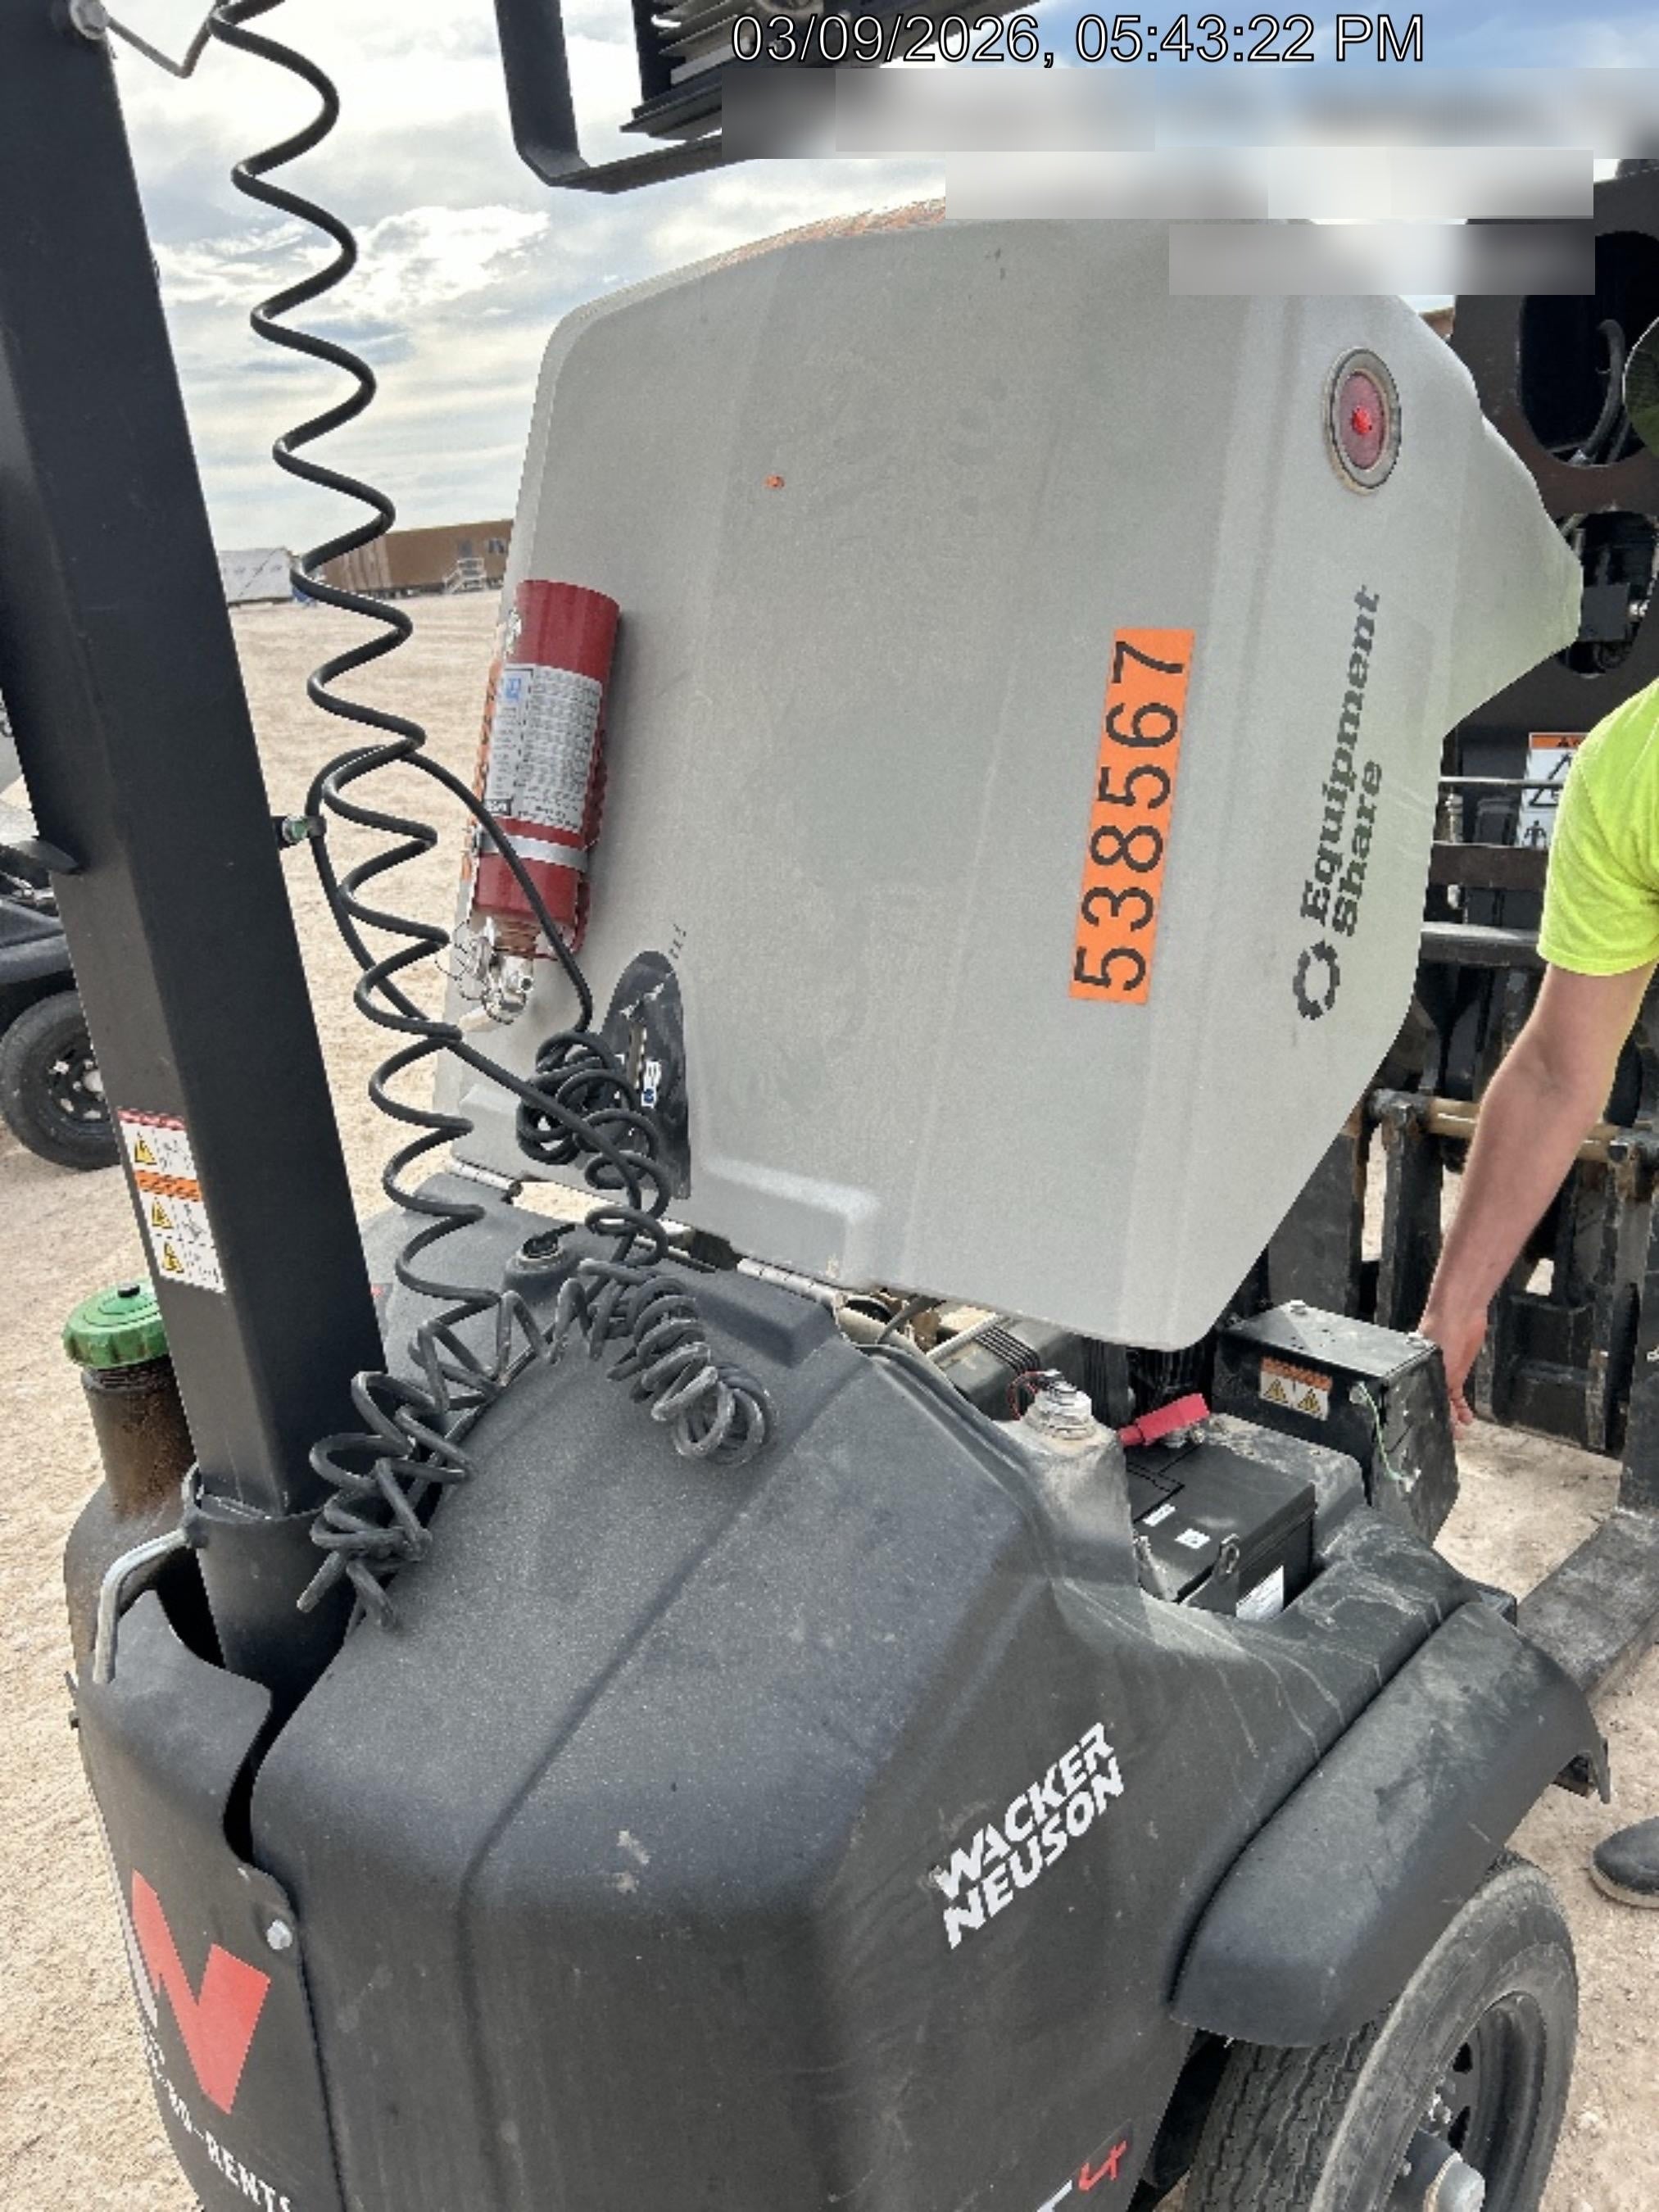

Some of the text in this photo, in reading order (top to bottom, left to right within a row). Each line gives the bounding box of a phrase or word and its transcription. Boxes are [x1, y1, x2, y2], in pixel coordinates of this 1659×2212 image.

[1074, 641, 1184, 990] 538567
[1300, 584, 1380, 925] Equipment
[1331, 760, 1382, 936] Share
[935, 1722, 1115, 1899] WACKER
[942, 1756, 1124, 1950] NEUSON
